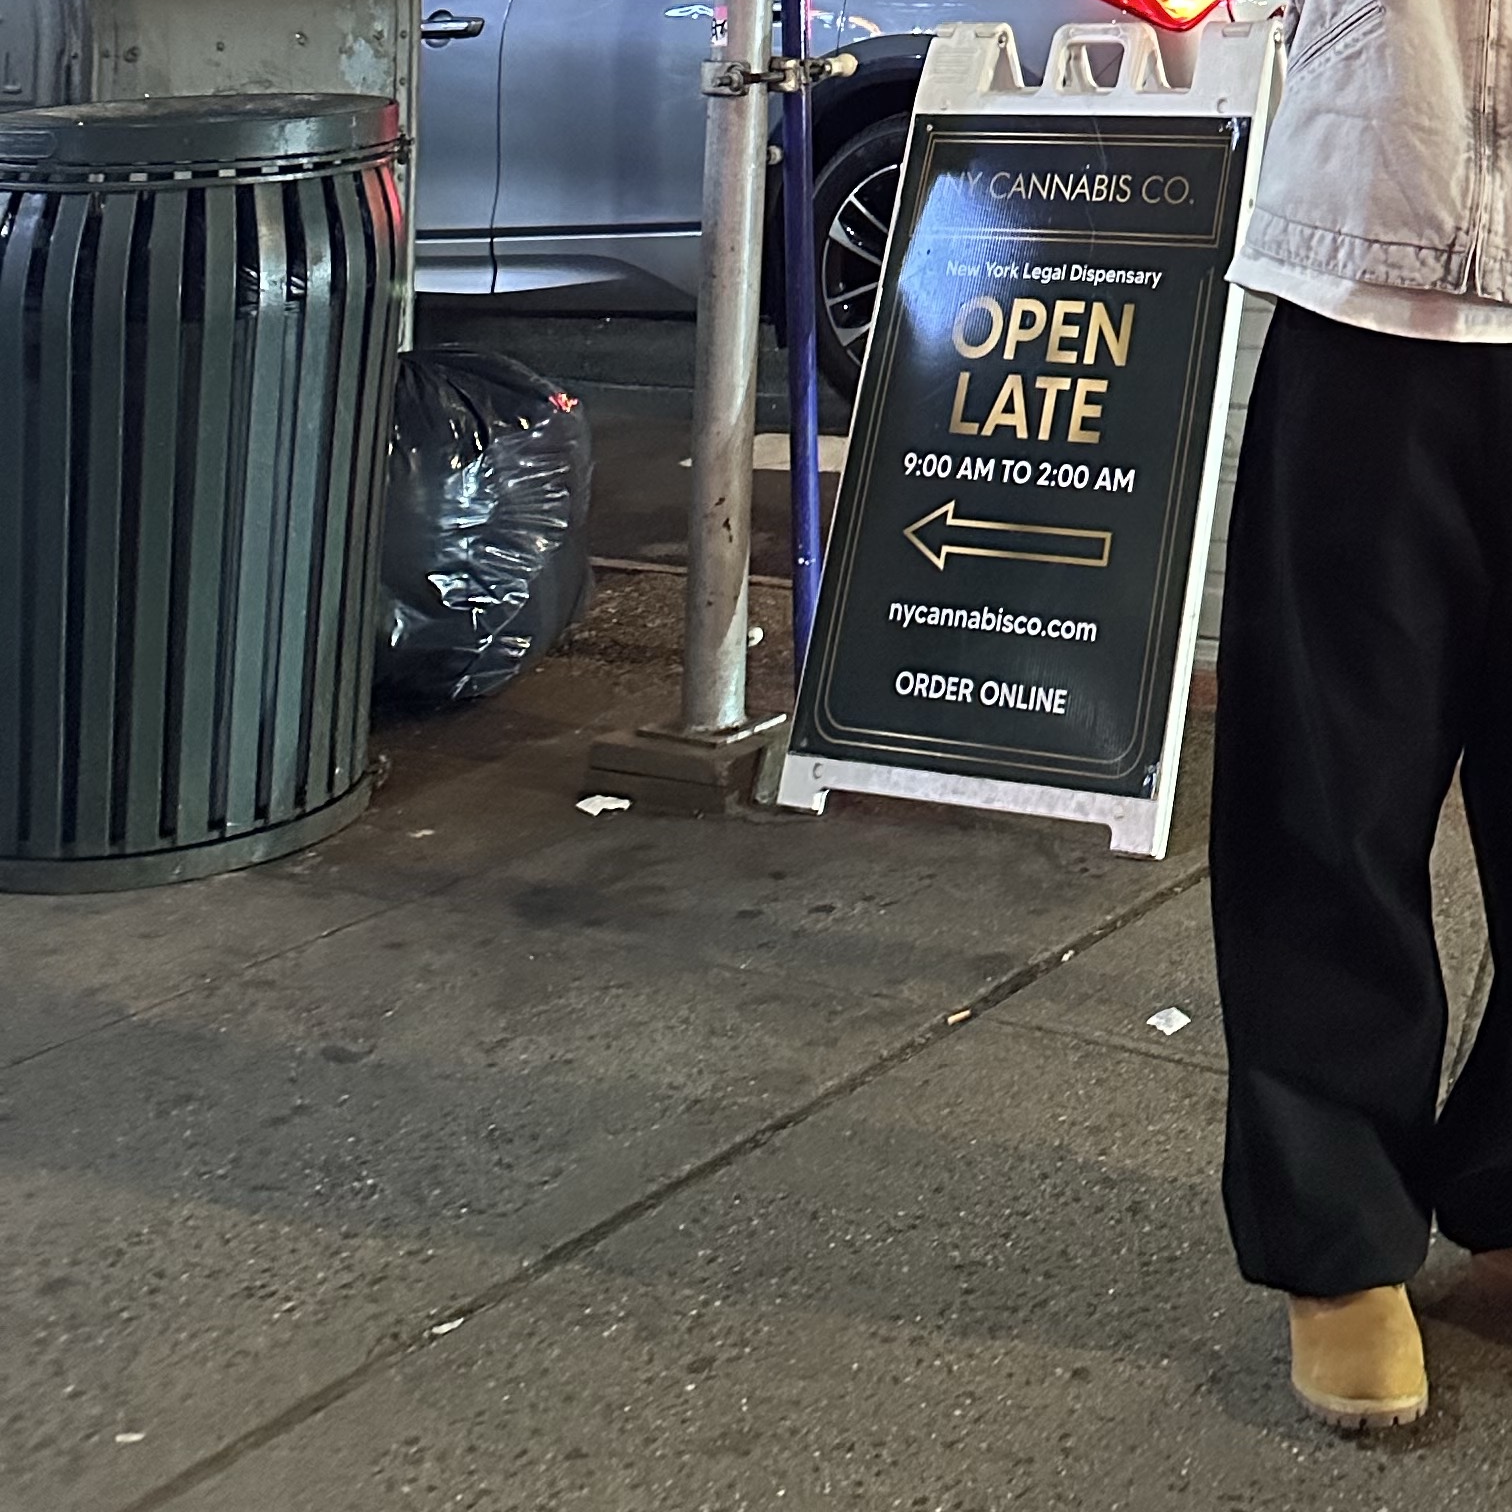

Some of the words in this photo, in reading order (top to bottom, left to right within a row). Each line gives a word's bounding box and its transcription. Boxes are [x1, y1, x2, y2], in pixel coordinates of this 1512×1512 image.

[989, 170, 1132, 203] CANNABIS
[1141, 174, 1195, 205] CO.
[945, 259, 980, 278] New
[985, 260, 1019, 280] York
[1022, 262, 1067, 285] Legal
[1069, 263, 1163, 290] Dispensary
[952, 295, 1136, 368] OPEN
[948, 371, 1109, 445] LATE
[903, 452, 953, 479] 9:00
[956, 456, 995, 483] AM
[1001, 459, 1032, 485] TO
[1036, 462, 1090, 490] 2:00
[1094, 467, 1136, 493] AM
[888, 602, 1098, 642] nycannabisco.com
[895, 671, 973, 704] ORDER
[980, 680, 1068, 715] ONLINE
